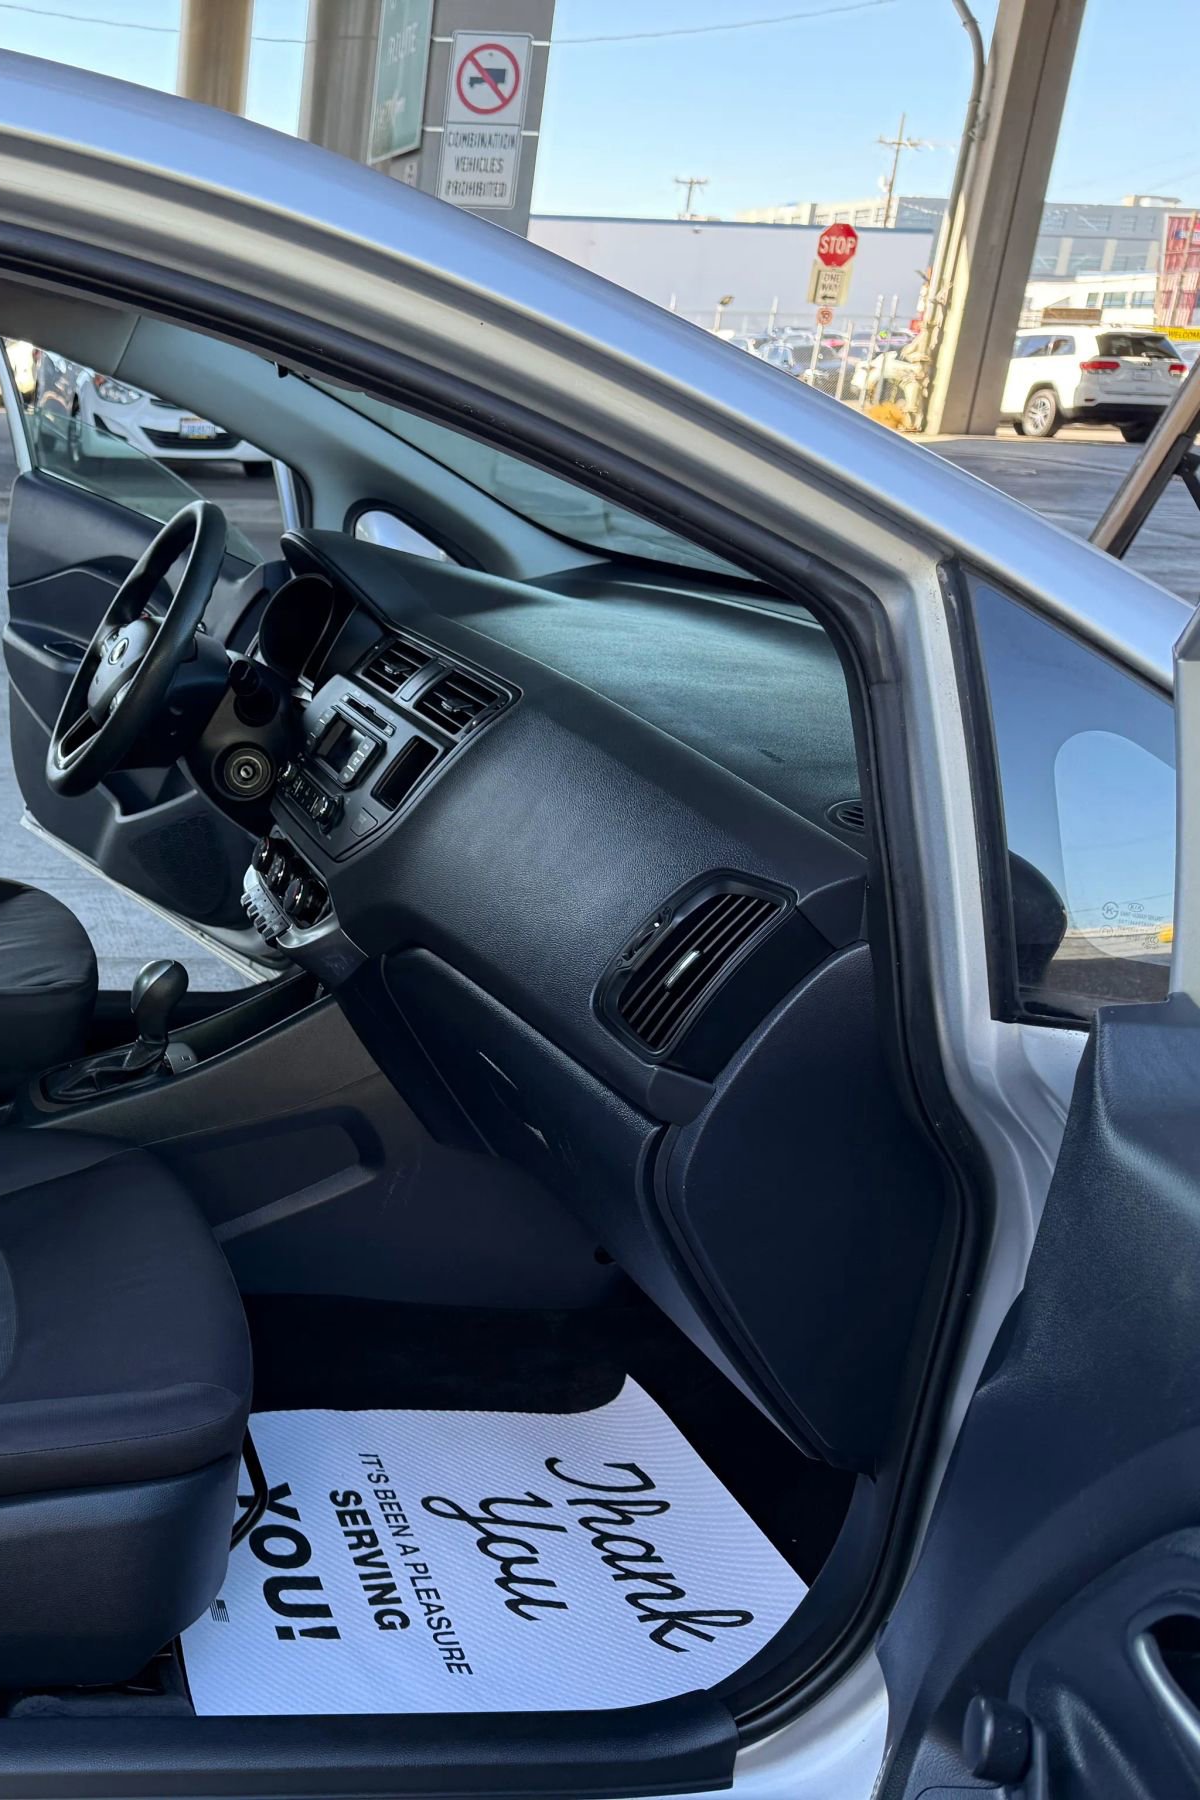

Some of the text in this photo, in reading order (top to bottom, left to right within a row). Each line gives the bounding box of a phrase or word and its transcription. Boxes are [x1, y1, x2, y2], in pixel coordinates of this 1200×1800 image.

[445, 180, 507, 198] PROHIBITED
[448, 131, 515, 149] COMBINATION
[455, 156, 504, 173] VEHICLES
[819, 235, 856, 255] STOP
[237, 1482, 341, 1640] YOU!
[329, 1489, 411, 1631] SERVING
[358, 1453, 473, 1675] IT'S BEEN A PLEASURE
[421, 1492, 568, 1621] You
[545, 1457, 754, 1653] Thank
